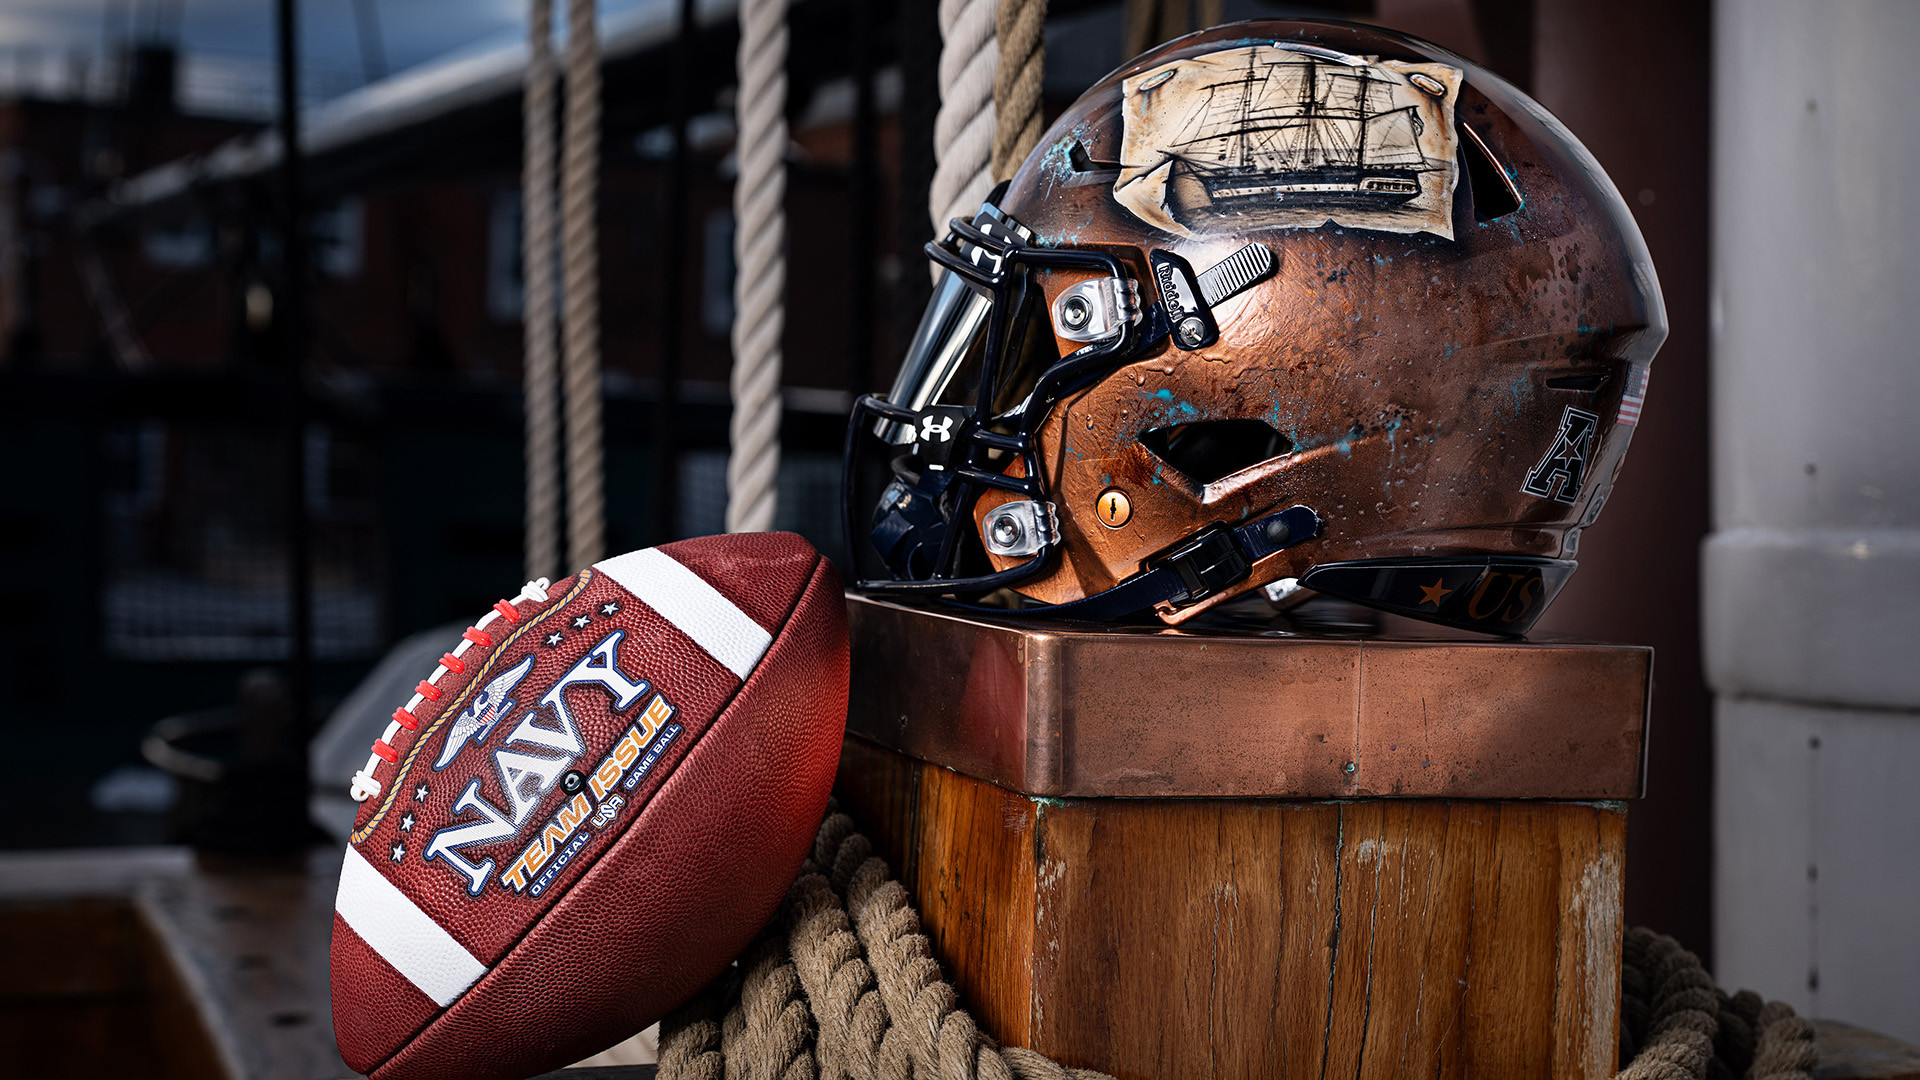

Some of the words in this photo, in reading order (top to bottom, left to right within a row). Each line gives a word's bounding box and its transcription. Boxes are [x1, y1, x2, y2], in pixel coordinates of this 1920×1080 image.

[1158, 263, 1184, 321] Riddell
[425, 631, 649, 895] NAVY
[502, 793, 592, 891] TEAM
[588, 695, 673, 800] ISSUE
[531, 833, 589, 895] OFFICIAL
[626, 755, 656, 789] GAME
[653, 726, 679, 757] BALL
